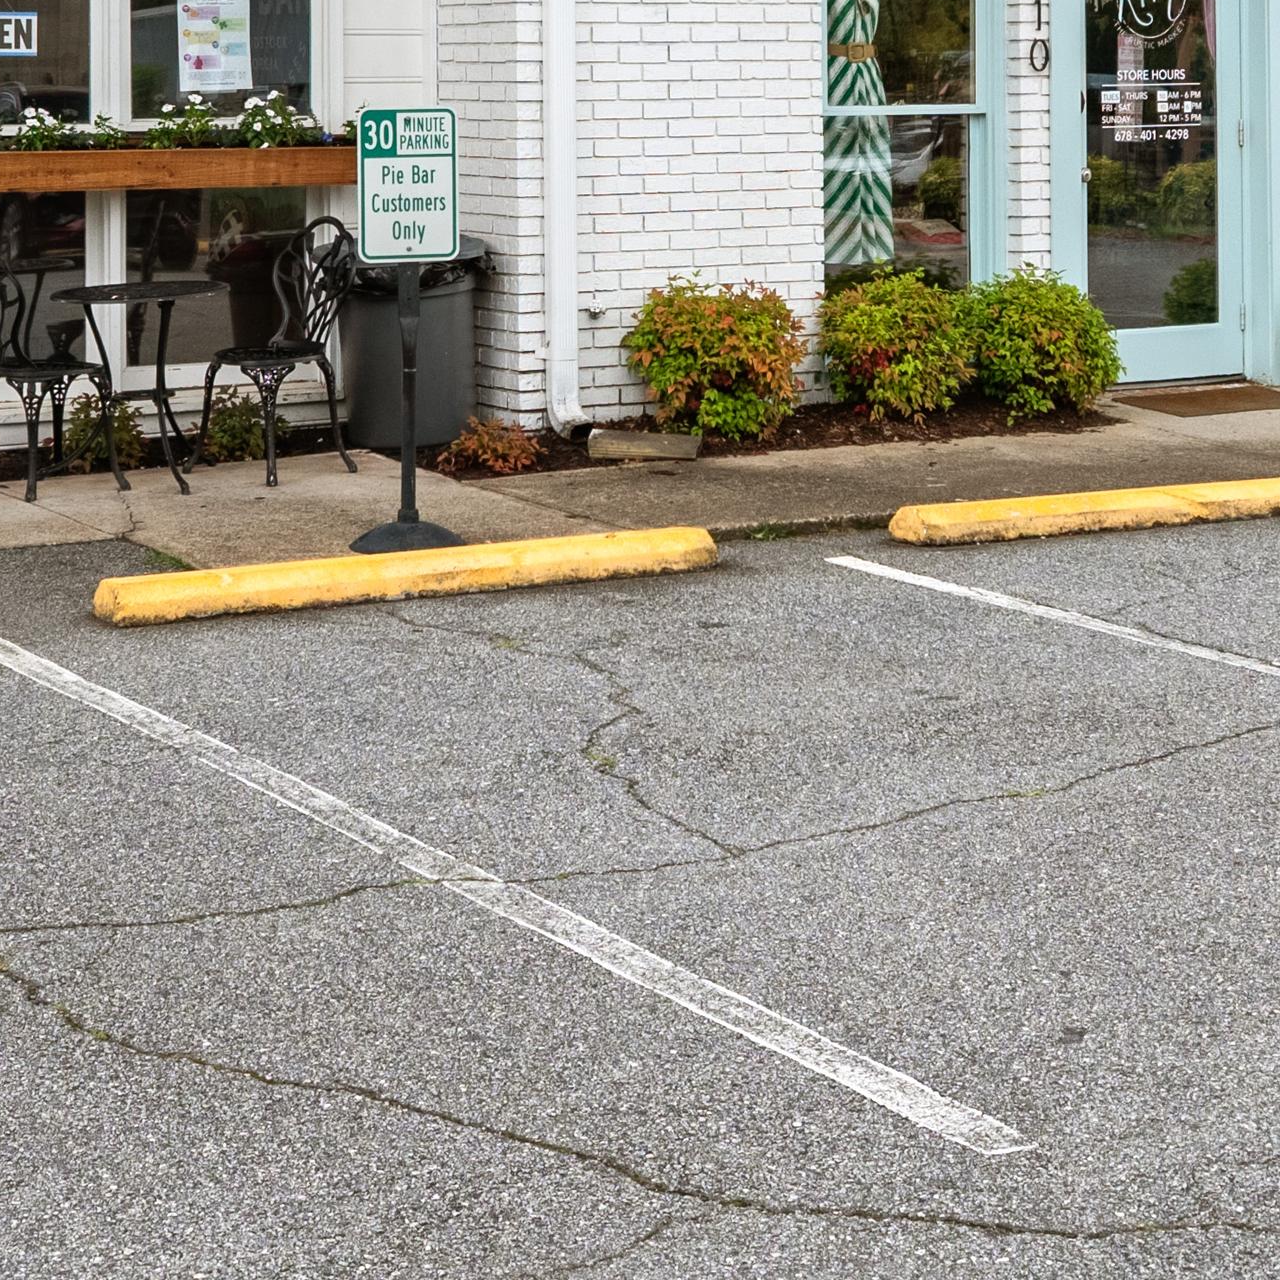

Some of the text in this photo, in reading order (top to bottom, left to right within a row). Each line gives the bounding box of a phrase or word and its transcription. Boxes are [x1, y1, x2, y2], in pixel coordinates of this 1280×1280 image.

[1117, 69, 1186, 81] STORE HOURS
[1125, 91, 1149, 100] THURS
[1190, 90, 1201, 98] PM
[1102, 116, 1132, 124] SUNDAY
[364, 116, 446, 150] 30 MINUTE
[1115, 130, 1132, 141] 678
[1140, 130, 1156, 140] 401
[1165, 129, 1189, 140] 4298
[400, 134, 449, 150] PARKING
[382, 165, 436, 184] Pie Bar
[371, 193, 446, 213] Customers
[392, 220, 426, 245] Only
